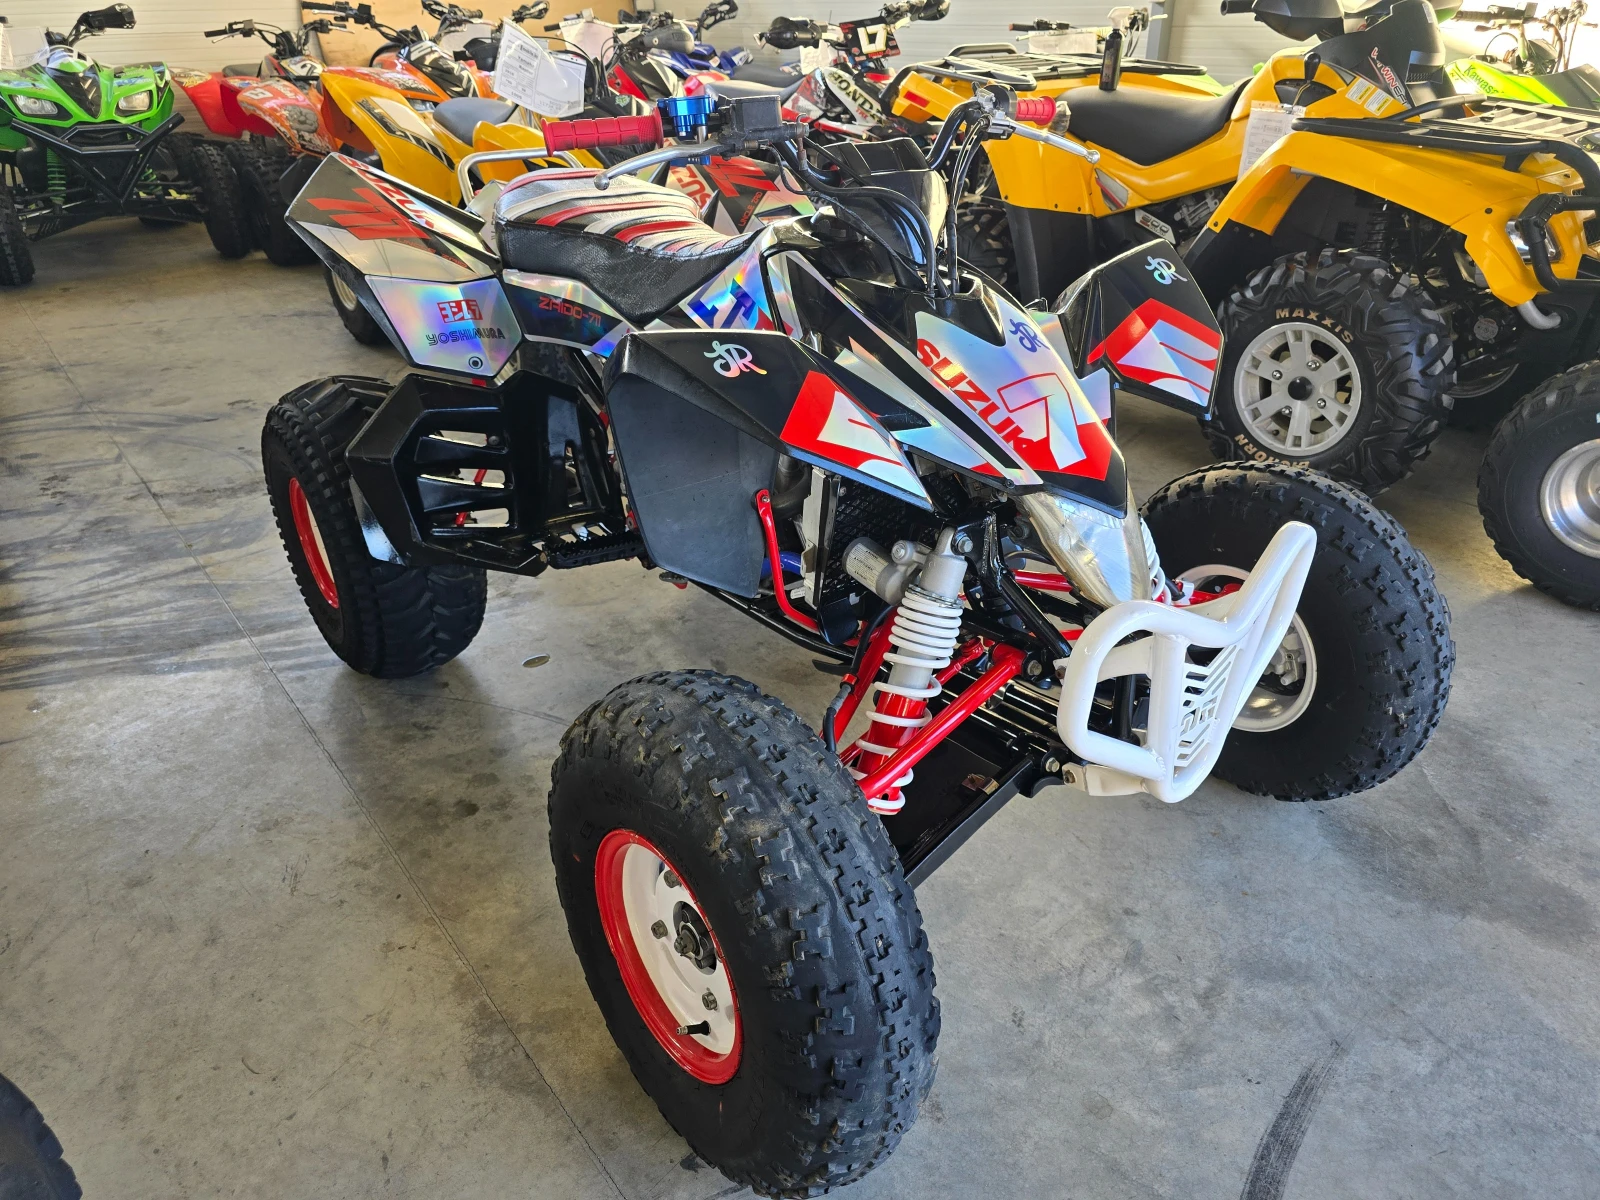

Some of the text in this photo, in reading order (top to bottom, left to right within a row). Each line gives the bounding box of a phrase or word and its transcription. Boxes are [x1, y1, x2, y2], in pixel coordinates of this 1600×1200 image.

[1464, 65, 1505, 95] Kawas
[425, 327, 506, 346] YOSHIMURA
[1275, 308, 1354, 344] MAXXIS
[917, 338, 1032, 453] SUZUK
